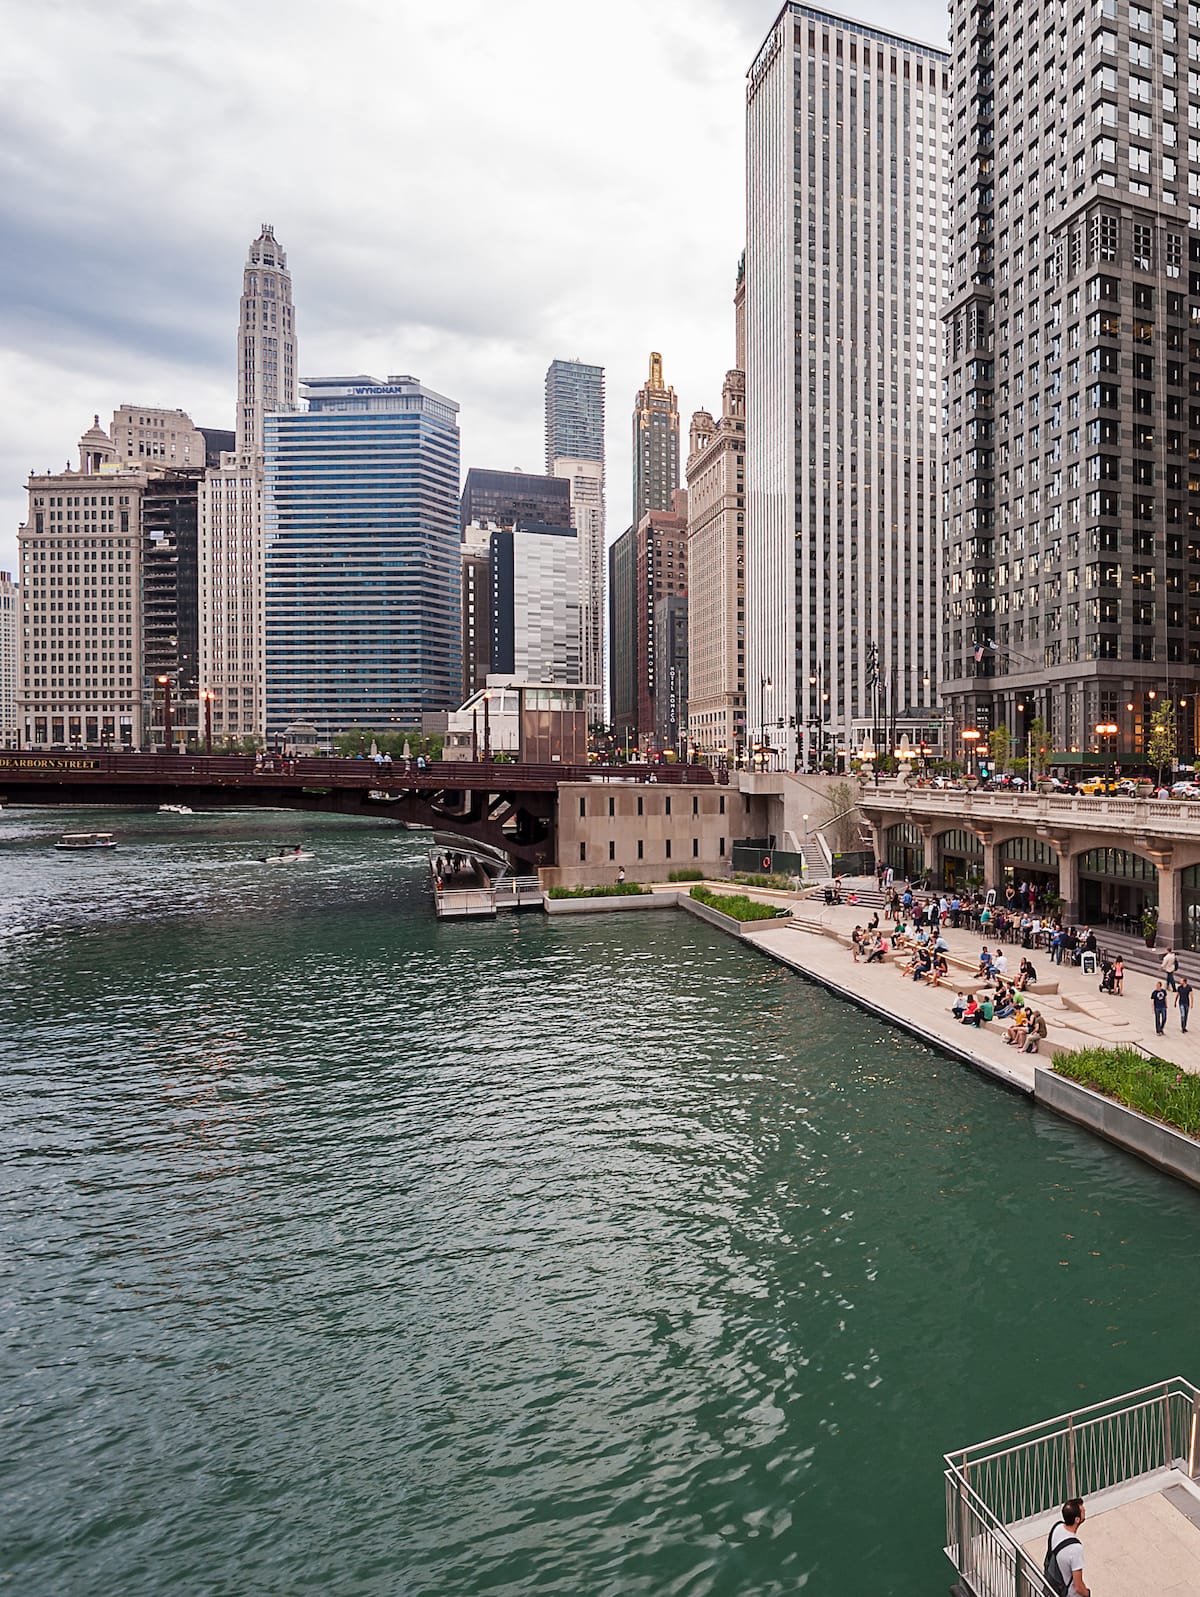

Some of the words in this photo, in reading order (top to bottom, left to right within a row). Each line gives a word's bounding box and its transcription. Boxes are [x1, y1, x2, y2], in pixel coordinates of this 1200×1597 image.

[355, 386, 402, 394] WYNDHAM
[0, 759, 55, 768] DEARBORN
[57, 760, 95, 769] STREET
